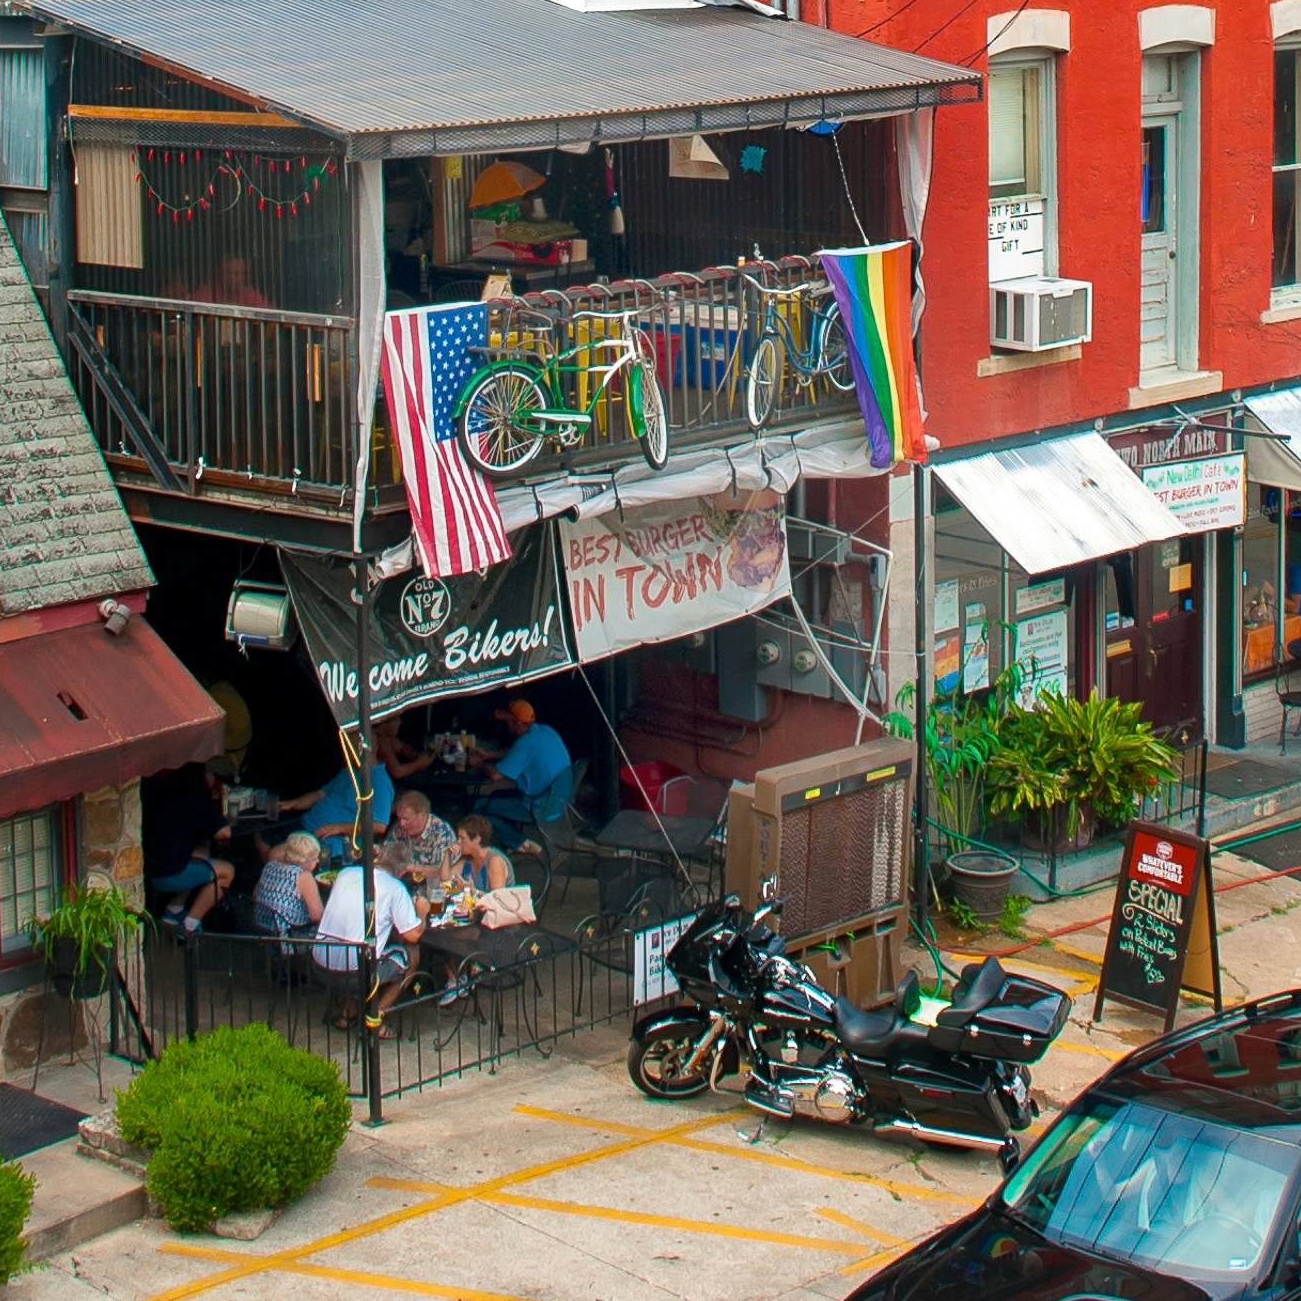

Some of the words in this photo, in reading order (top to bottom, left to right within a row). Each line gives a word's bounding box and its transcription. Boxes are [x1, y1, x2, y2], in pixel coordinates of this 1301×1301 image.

[1024, 201, 1029, 213] A
[1010, 219, 1028, 231] KIND
[1002, 240, 1019, 252] GIFT
[1171, 486, 1201, 502] BURGER
[1203, 483, 1212, 495] IN
[1215, 479, 1239, 495] TOWN
[570, 532, 621, 571] BEST
[625, 514, 714, 558] BURGER
[415, 580, 434, 592] OLD
[573, 574, 605, 632] IN
[615, 546, 724, 621] TOWN
[319, 651, 429, 703] Wecome
[443, 605, 555, 670] Bikers!
[1138, 861, 1184, 885] COMFORTABLE
[1142, 853, 1183, 874] WHATEVER'S
[1128, 879, 1183, 924] SPECIAL
